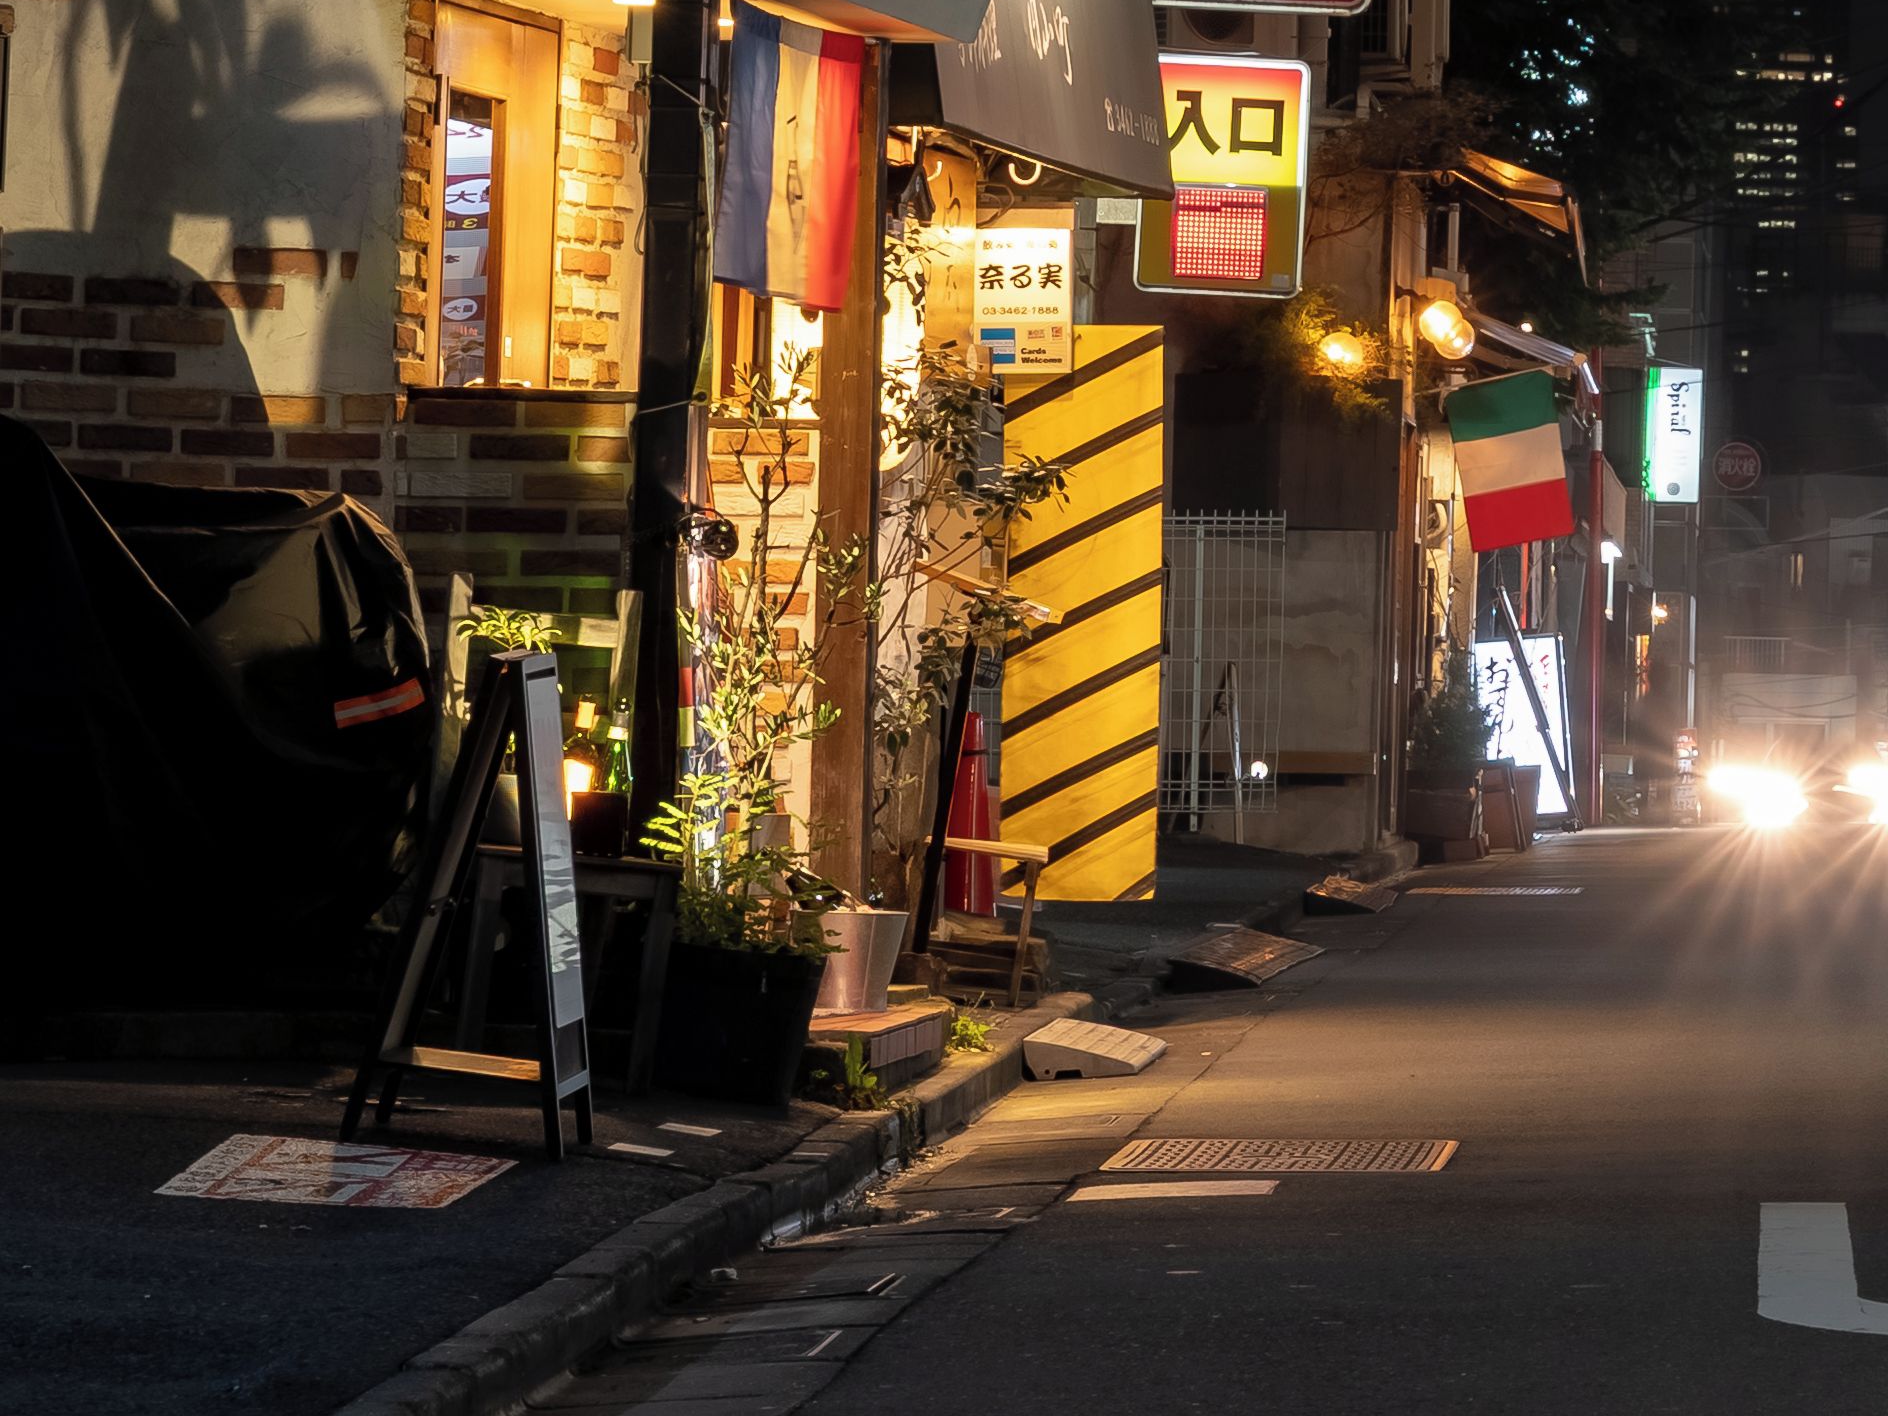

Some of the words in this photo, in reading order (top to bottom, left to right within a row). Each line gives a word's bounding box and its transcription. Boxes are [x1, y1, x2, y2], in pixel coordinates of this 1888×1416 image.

[1166, 90, 1286, 157] 入口
[978, 263, 1063, 290] 奈る実
